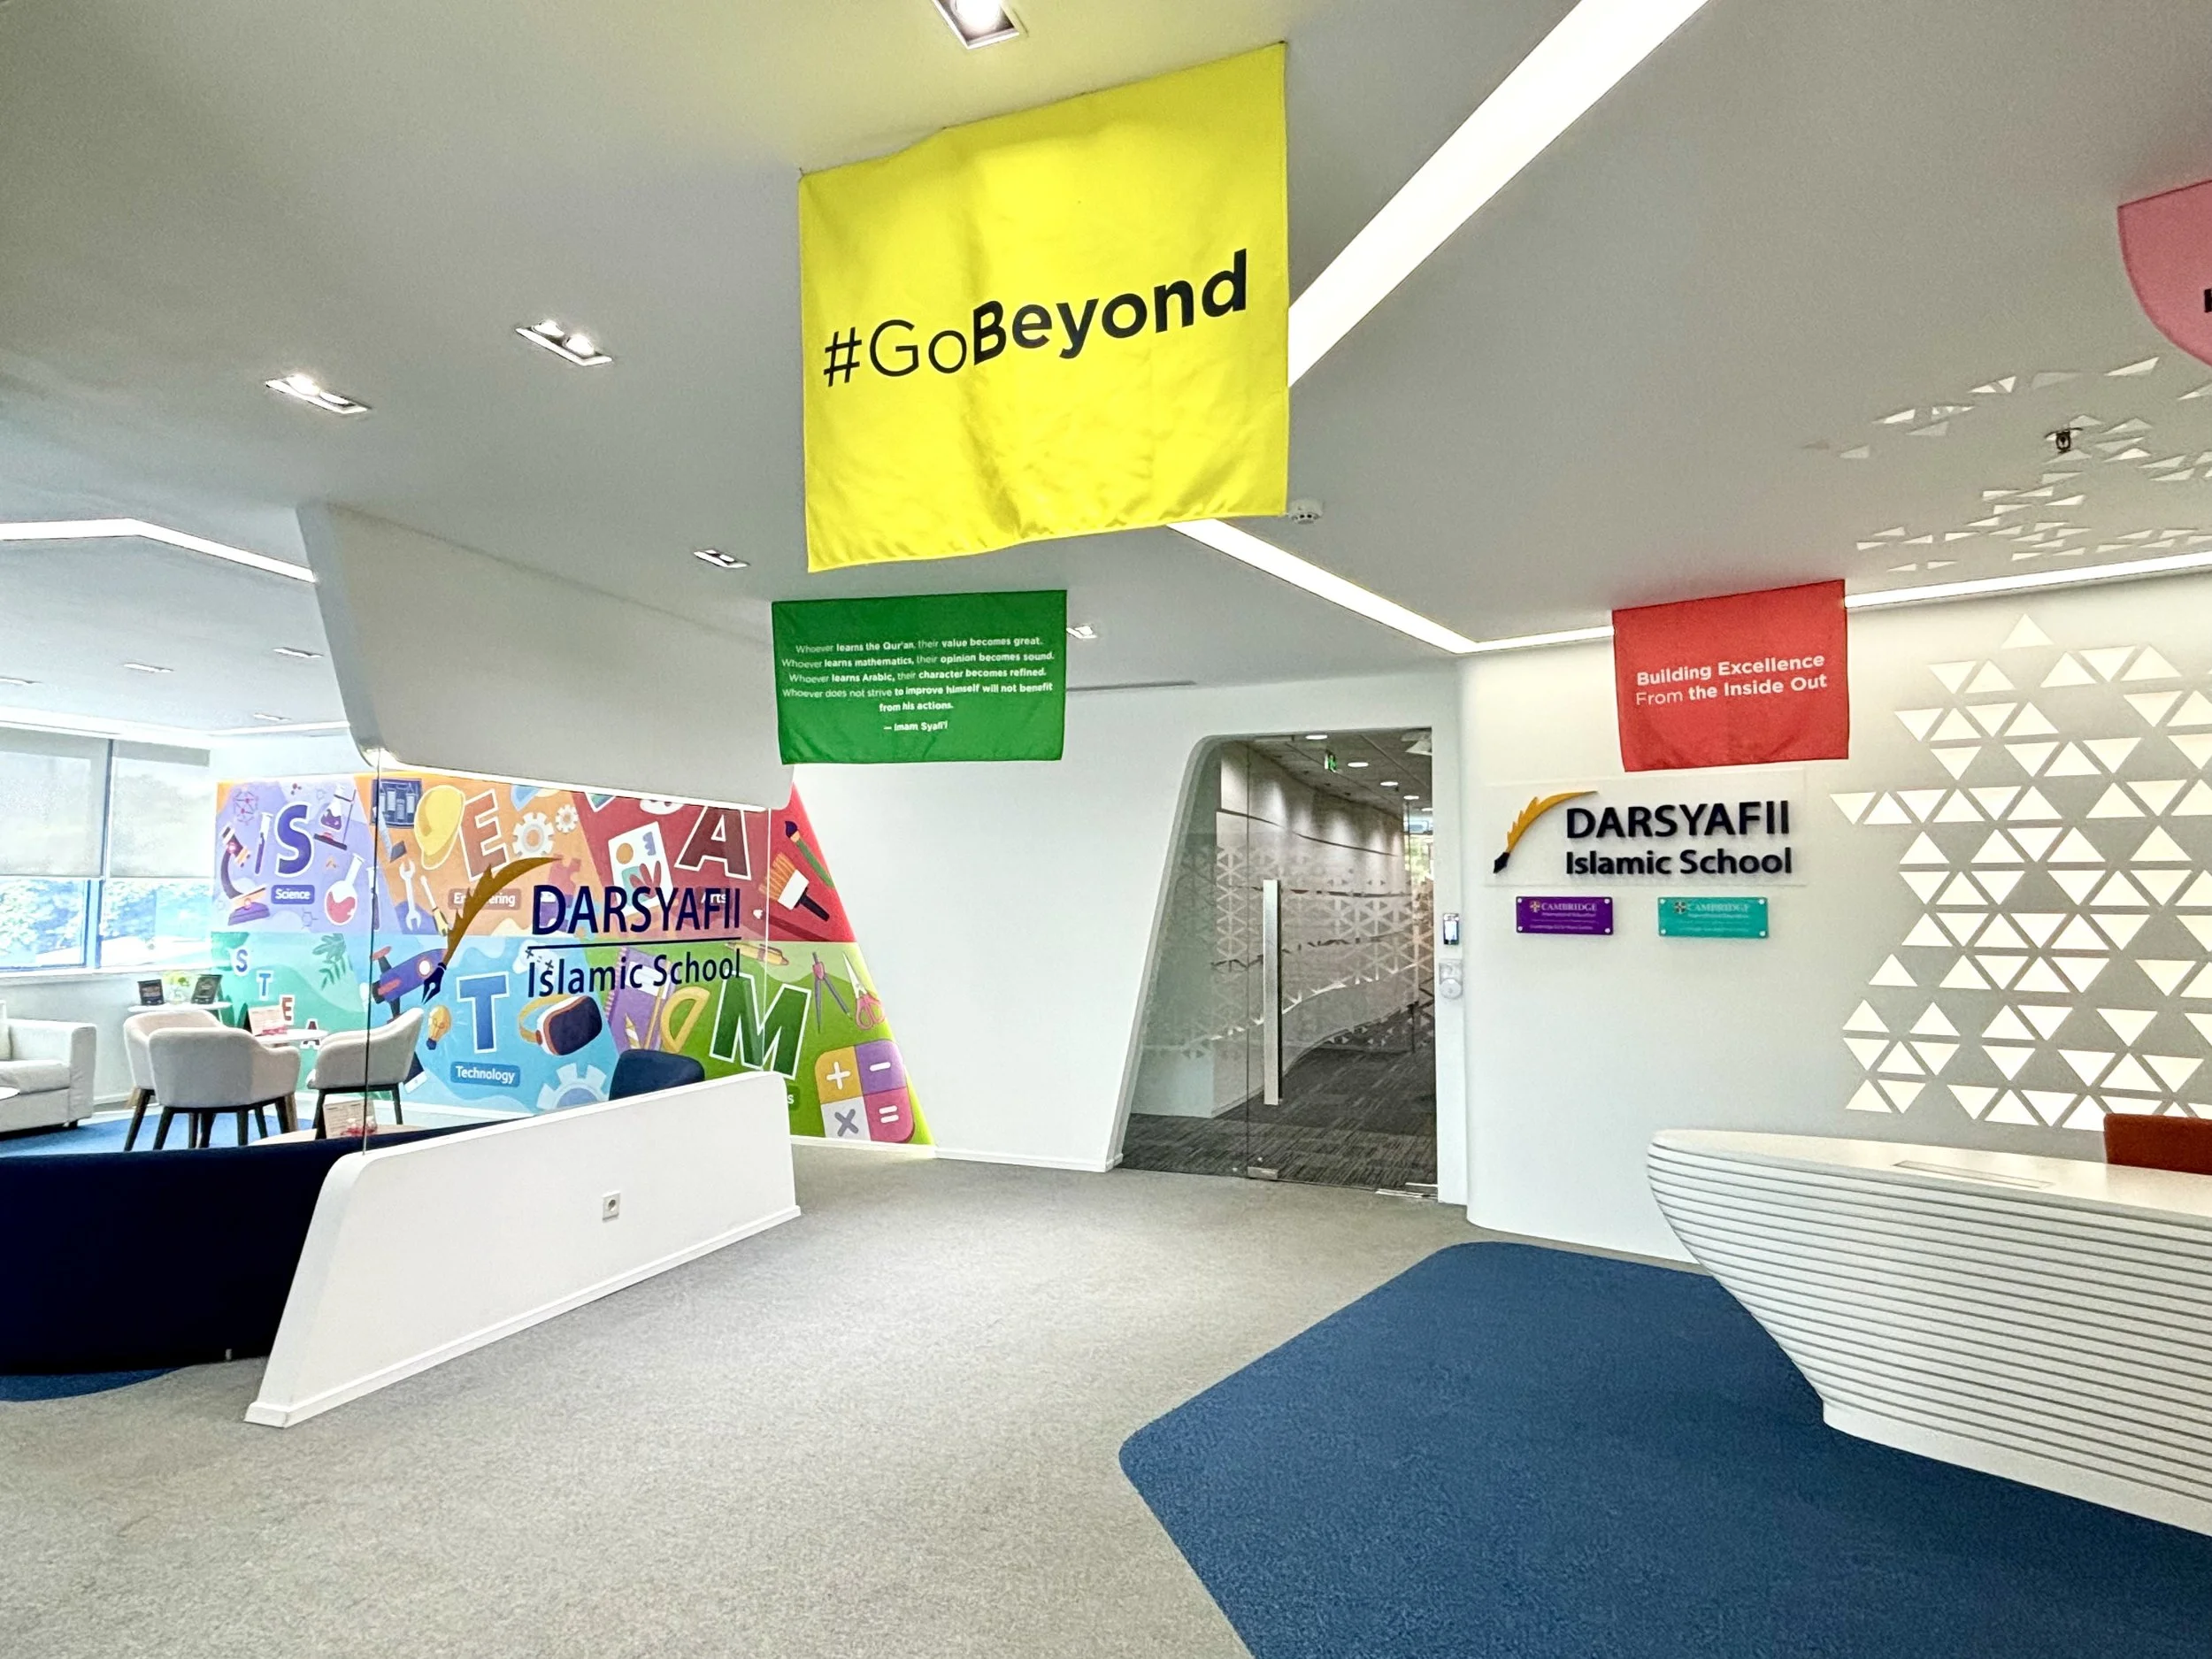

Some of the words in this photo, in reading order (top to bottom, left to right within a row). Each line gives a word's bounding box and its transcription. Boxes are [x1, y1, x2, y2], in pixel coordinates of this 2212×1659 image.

[823, 248, 1247, 388] #GoBeyond
[796, 644, 833, 653] Whoever
[837, 643, 864, 652] learns
[865, 642, 879, 651] the
[918, 640, 939, 649] their
[941, 638, 967, 648] value
[970, 637, 1010, 646] becomes
[1014, 637, 1043, 648] great.
[781, 658, 822, 669] Whoever
[825, 658, 852, 667] learns
[855, 657, 914, 667] mathematics,
[917, 655, 937, 664] their
[941, 654, 976, 664] opinion
[979, 653, 1020, 662] becomes
[1024, 651, 1055, 661] sound.
[789, 673, 829, 683] Whoever
[832, 673, 860, 682] learns
[862, 672, 895, 682] Arabic,
[897, 671, 916, 680] their
[918, 670, 963, 679] character
[965, 669, 1008, 678] becomes
[1010, 667, 1047, 677] refined.
[1637, 665, 1712, 687] Building
[1717, 655, 1824, 677] Excellence
[782, 688, 823, 698] Whoever
[826, 688, 847, 697] does
[849, 688, 865, 697] not
[867, 687, 892, 697] strive
[905, 686, 943, 696] improve
[946, 684, 980, 694] himself
[982, 684, 998, 693] will
[1001, 684, 1018, 693] not
[1019, 682, 1053, 692] benefit
[1636, 689, 1683, 705] From
[1688, 685, 1717, 701] the
[1724, 680, 1784, 697] Inside
[1790, 673, 1827, 692] Out
[879, 703, 901, 711] from
[902, 702, 915, 710] his
[917, 701, 954, 710] actions.
[894, 722, 918, 732] Imam
[1566, 800, 1790, 839] DARSYAFII
[1566, 850, 1672, 875] Islamic
[1679, 847, 1792, 874] School
[275, 888, 311, 900] Science
[453, 892, 516, 907] Enering
[533, 884, 741, 935] DARSYAFII
[1541, 902, 1597, 911] CAMBRIDGE
[528, 956, 643, 998] Islamic
[653, 949, 741, 987] School
[456, 1064, 515, 1084] Technology
